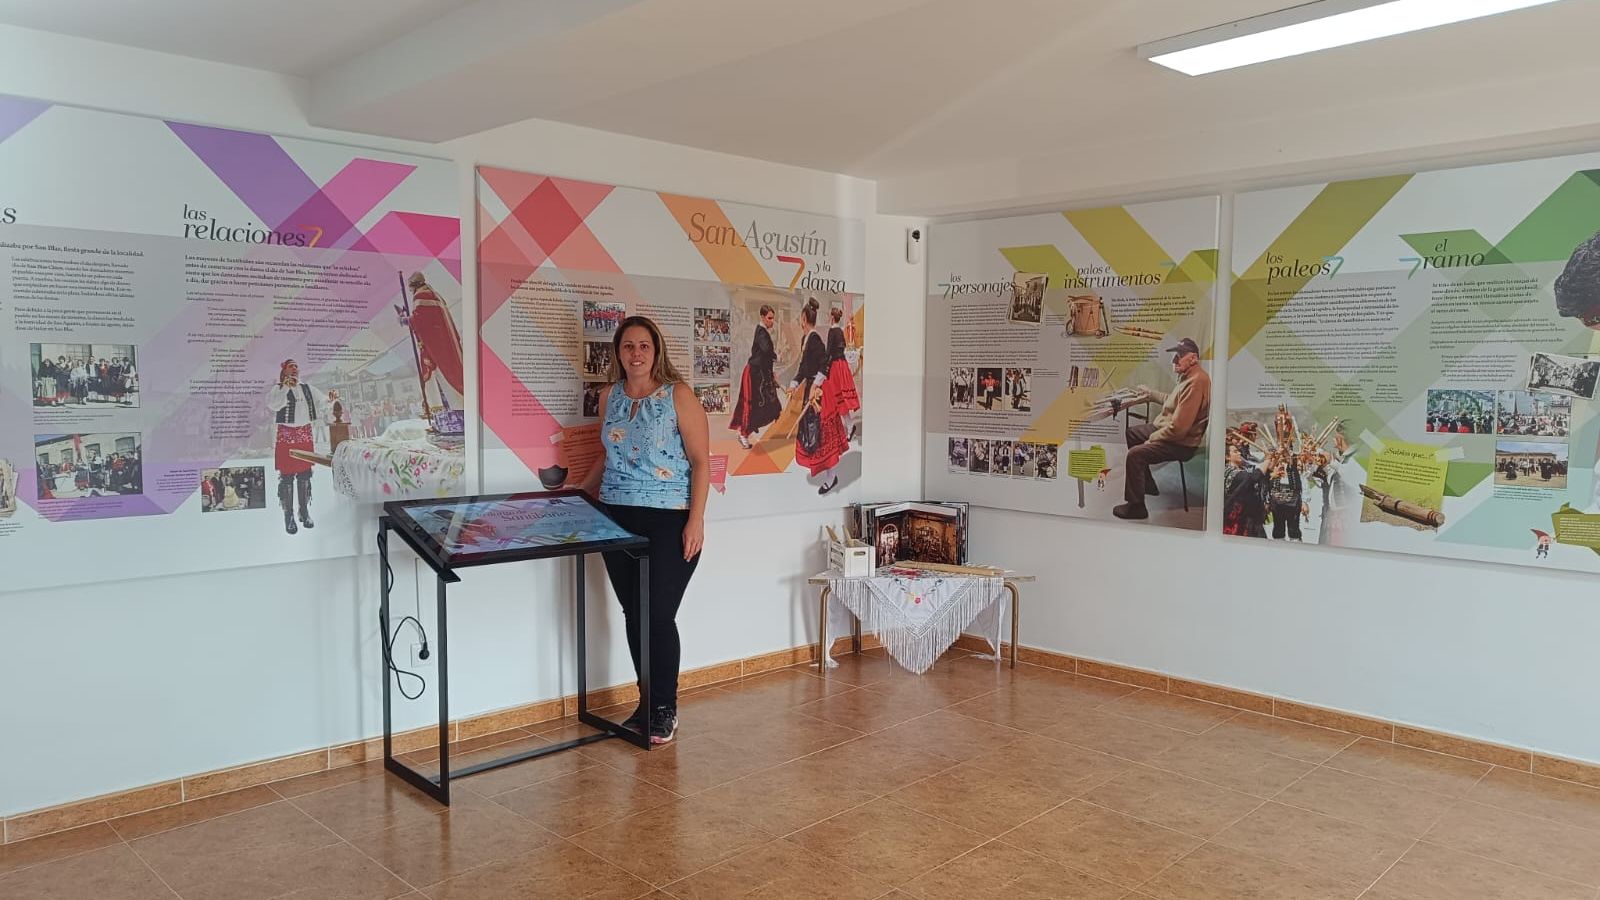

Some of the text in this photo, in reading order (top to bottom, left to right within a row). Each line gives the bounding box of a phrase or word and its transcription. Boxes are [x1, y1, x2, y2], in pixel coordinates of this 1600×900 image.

[0, 207, 17, 225] s
[183, 203, 207, 221] las
[184, 217, 306, 247] relaciones
[688, 212, 828, 261] San Agustín
[1434, 238, 1448, 252] el
[813, 260, 831, 275] y la
[1266, 252, 1284, 265] los
[1422, 249, 1486, 271] ramo
[950, 272, 962, 284] los
[1064, 270, 1161, 290] instrumentos
[1076, 264, 1111, 281] palos e
[1266, 258, 1331, 286] paleos
[801, 270, 846, 295] danza
[950, 277, 1016, 300] personajes
